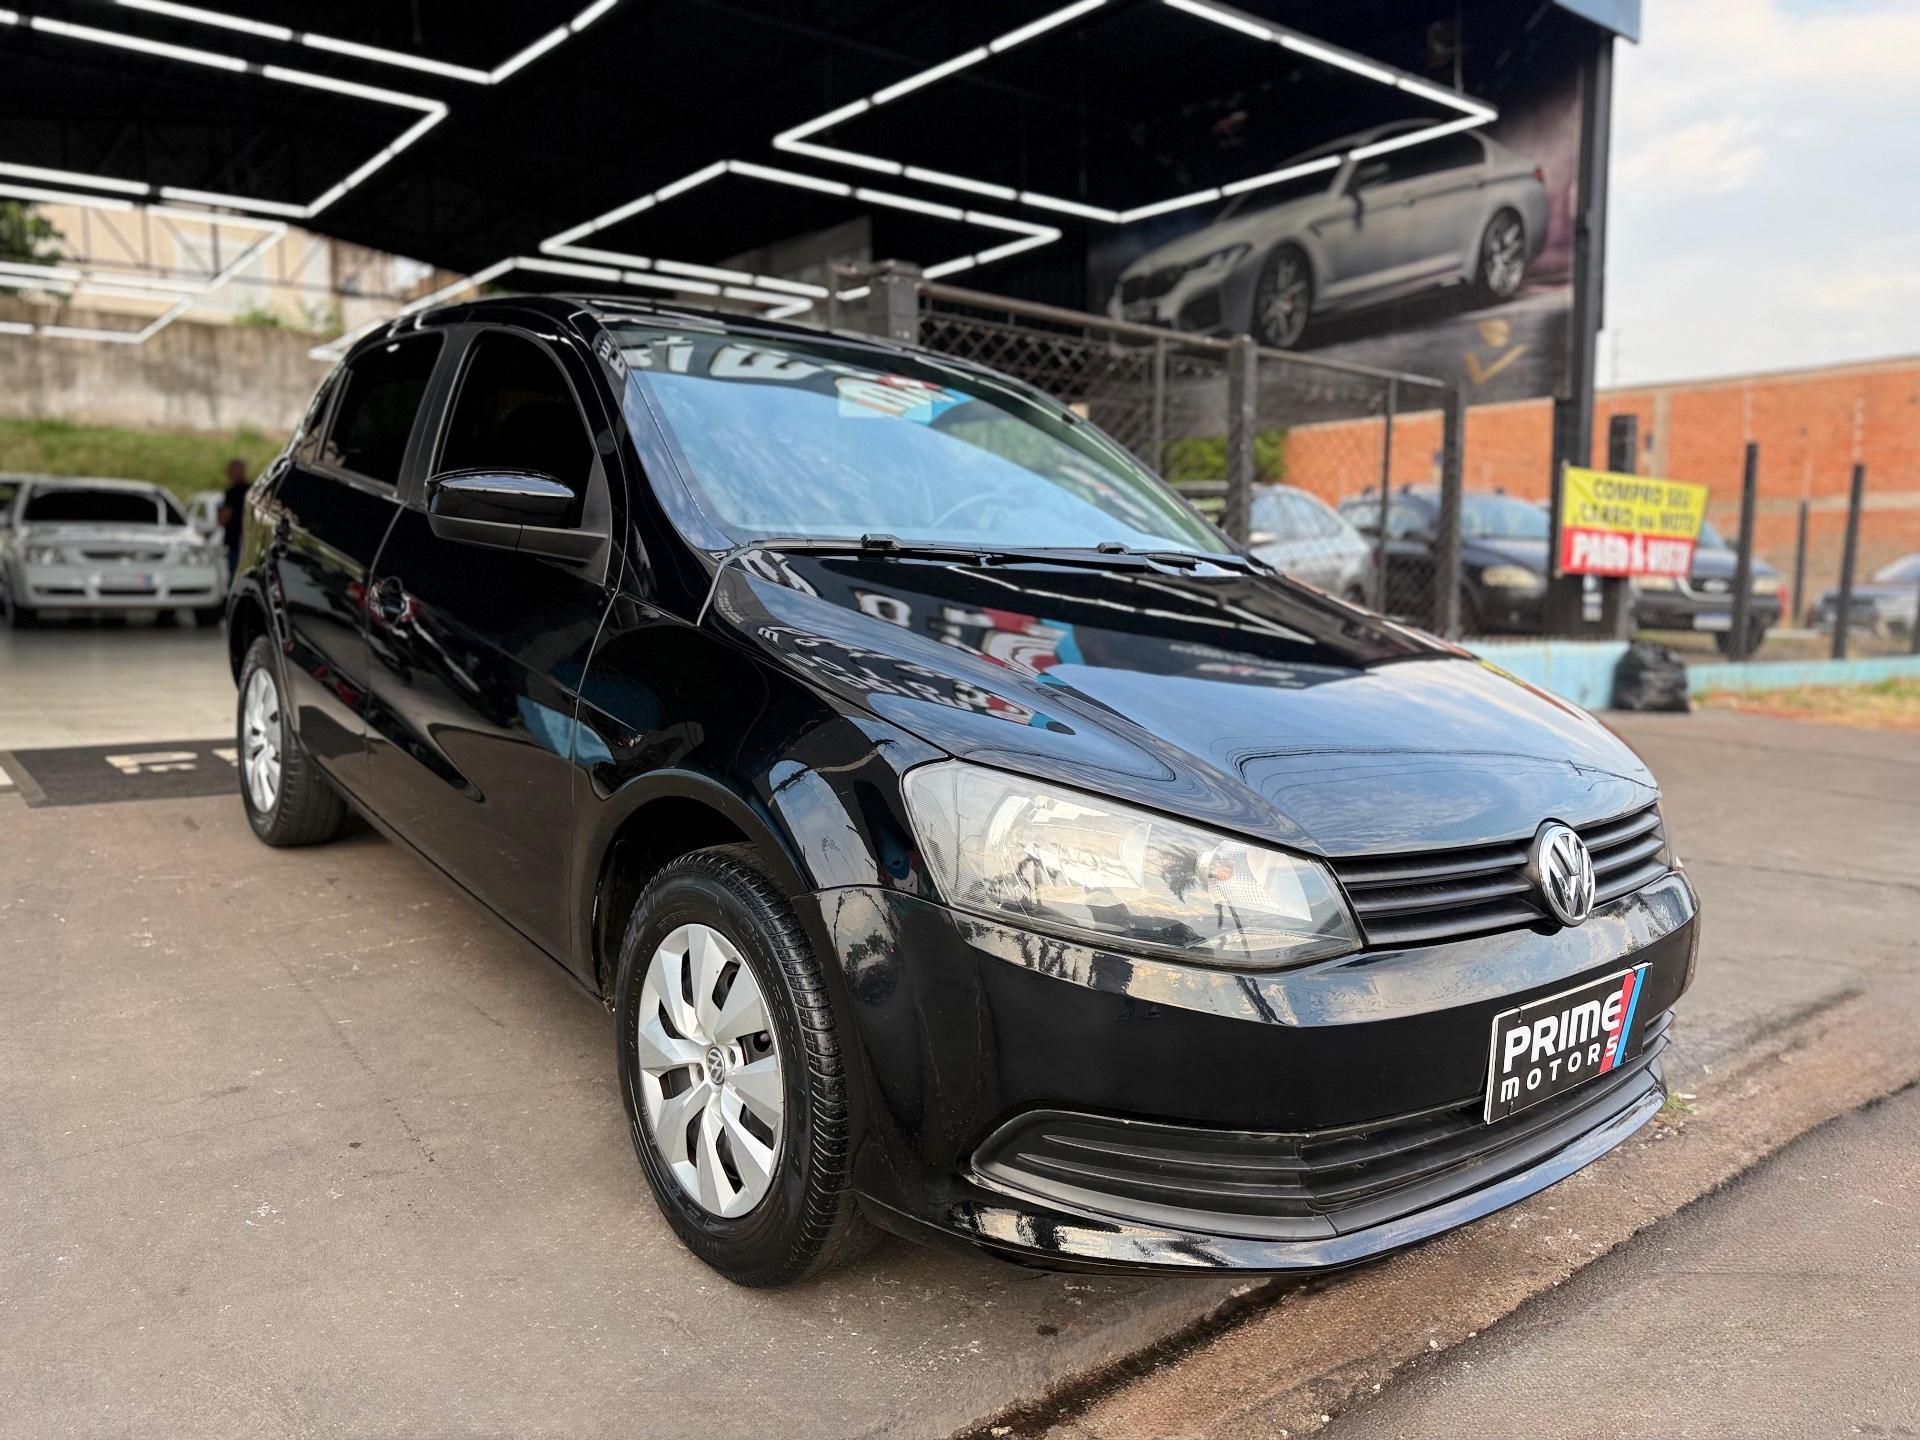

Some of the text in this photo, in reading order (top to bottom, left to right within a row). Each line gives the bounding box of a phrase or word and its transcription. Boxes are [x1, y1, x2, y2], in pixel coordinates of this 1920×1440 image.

[1571, 533, 1629, 570] PAGO
[1502, 989, 1623, 1074] PRIME
[1499, 1034, 1618, 1103] MOTORS
